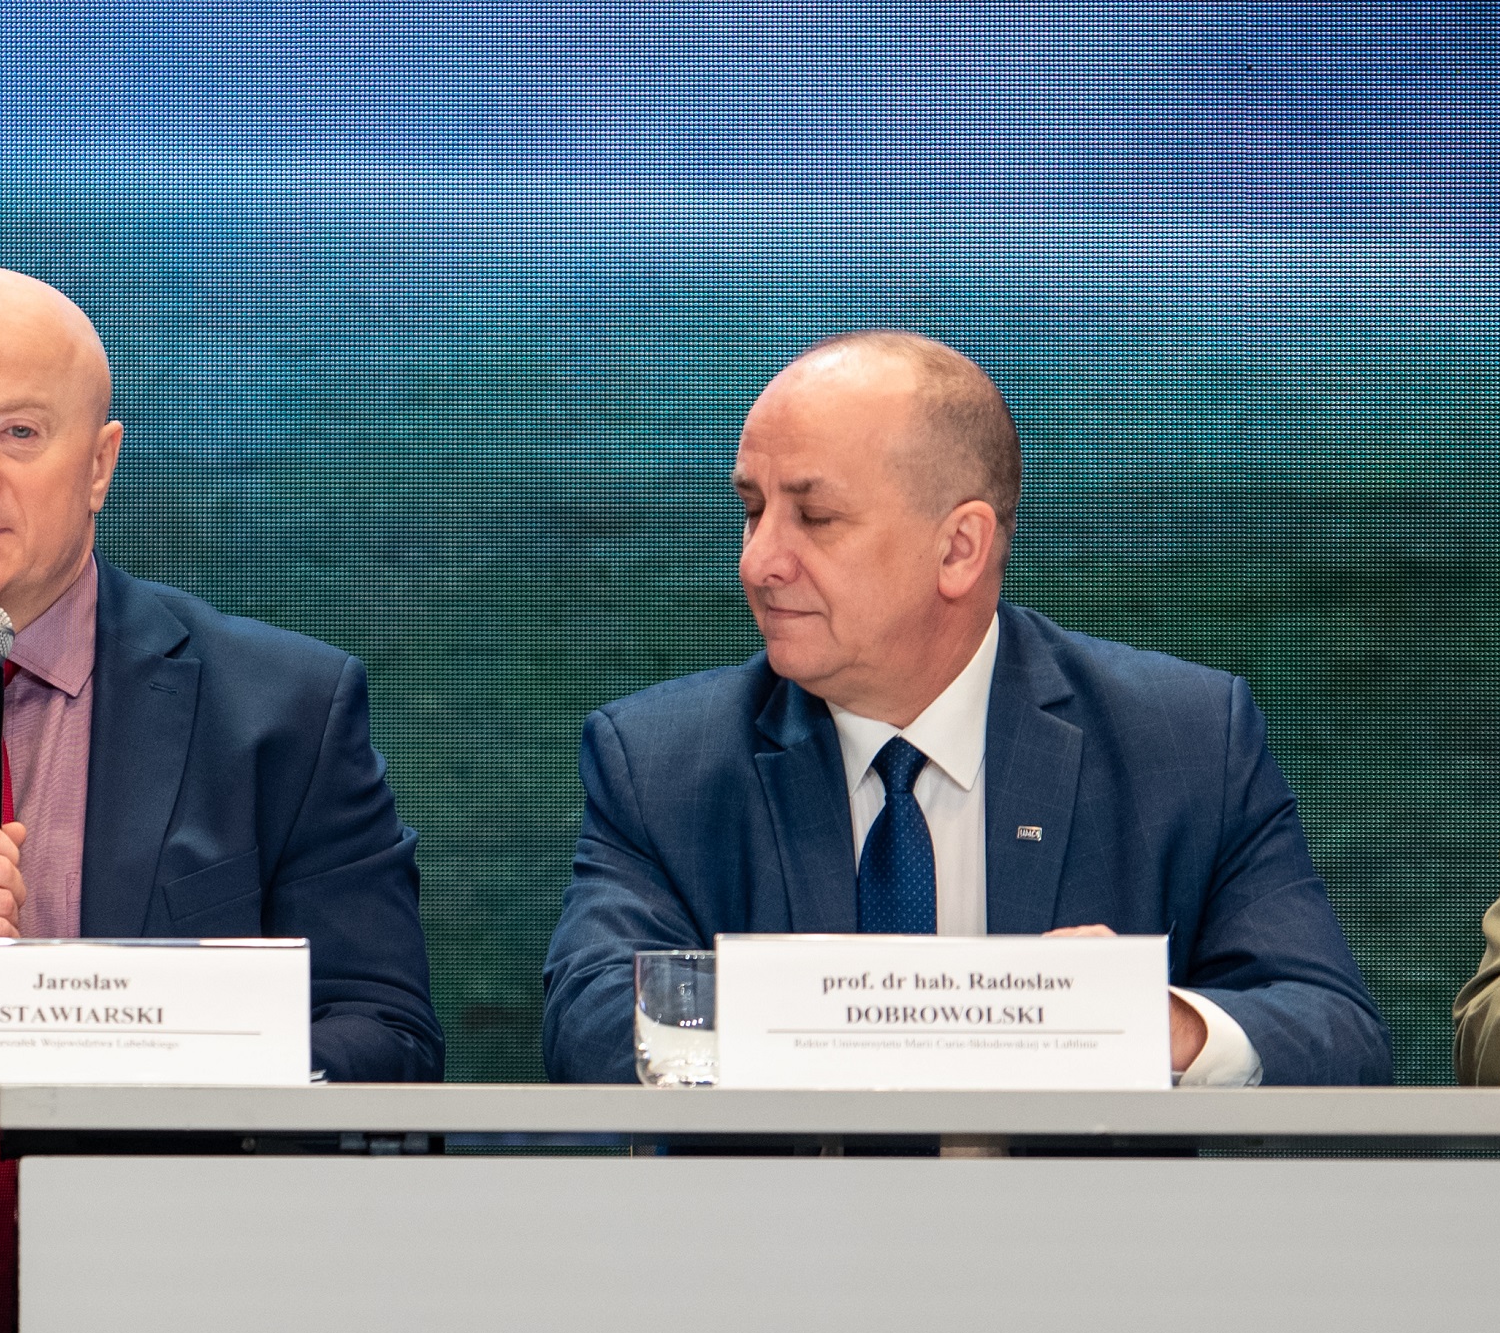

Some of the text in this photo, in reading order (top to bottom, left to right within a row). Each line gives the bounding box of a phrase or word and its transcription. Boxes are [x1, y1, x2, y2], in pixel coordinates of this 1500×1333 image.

[32, 973, 128, 991] Jarosław
[823, 972, 1074, 995] prof. dr hab. Radosław
[0, 1006, 163, 1025] STAWIARSKI
[846, 1006, 1044, 1025] DOBROWOLSKI
